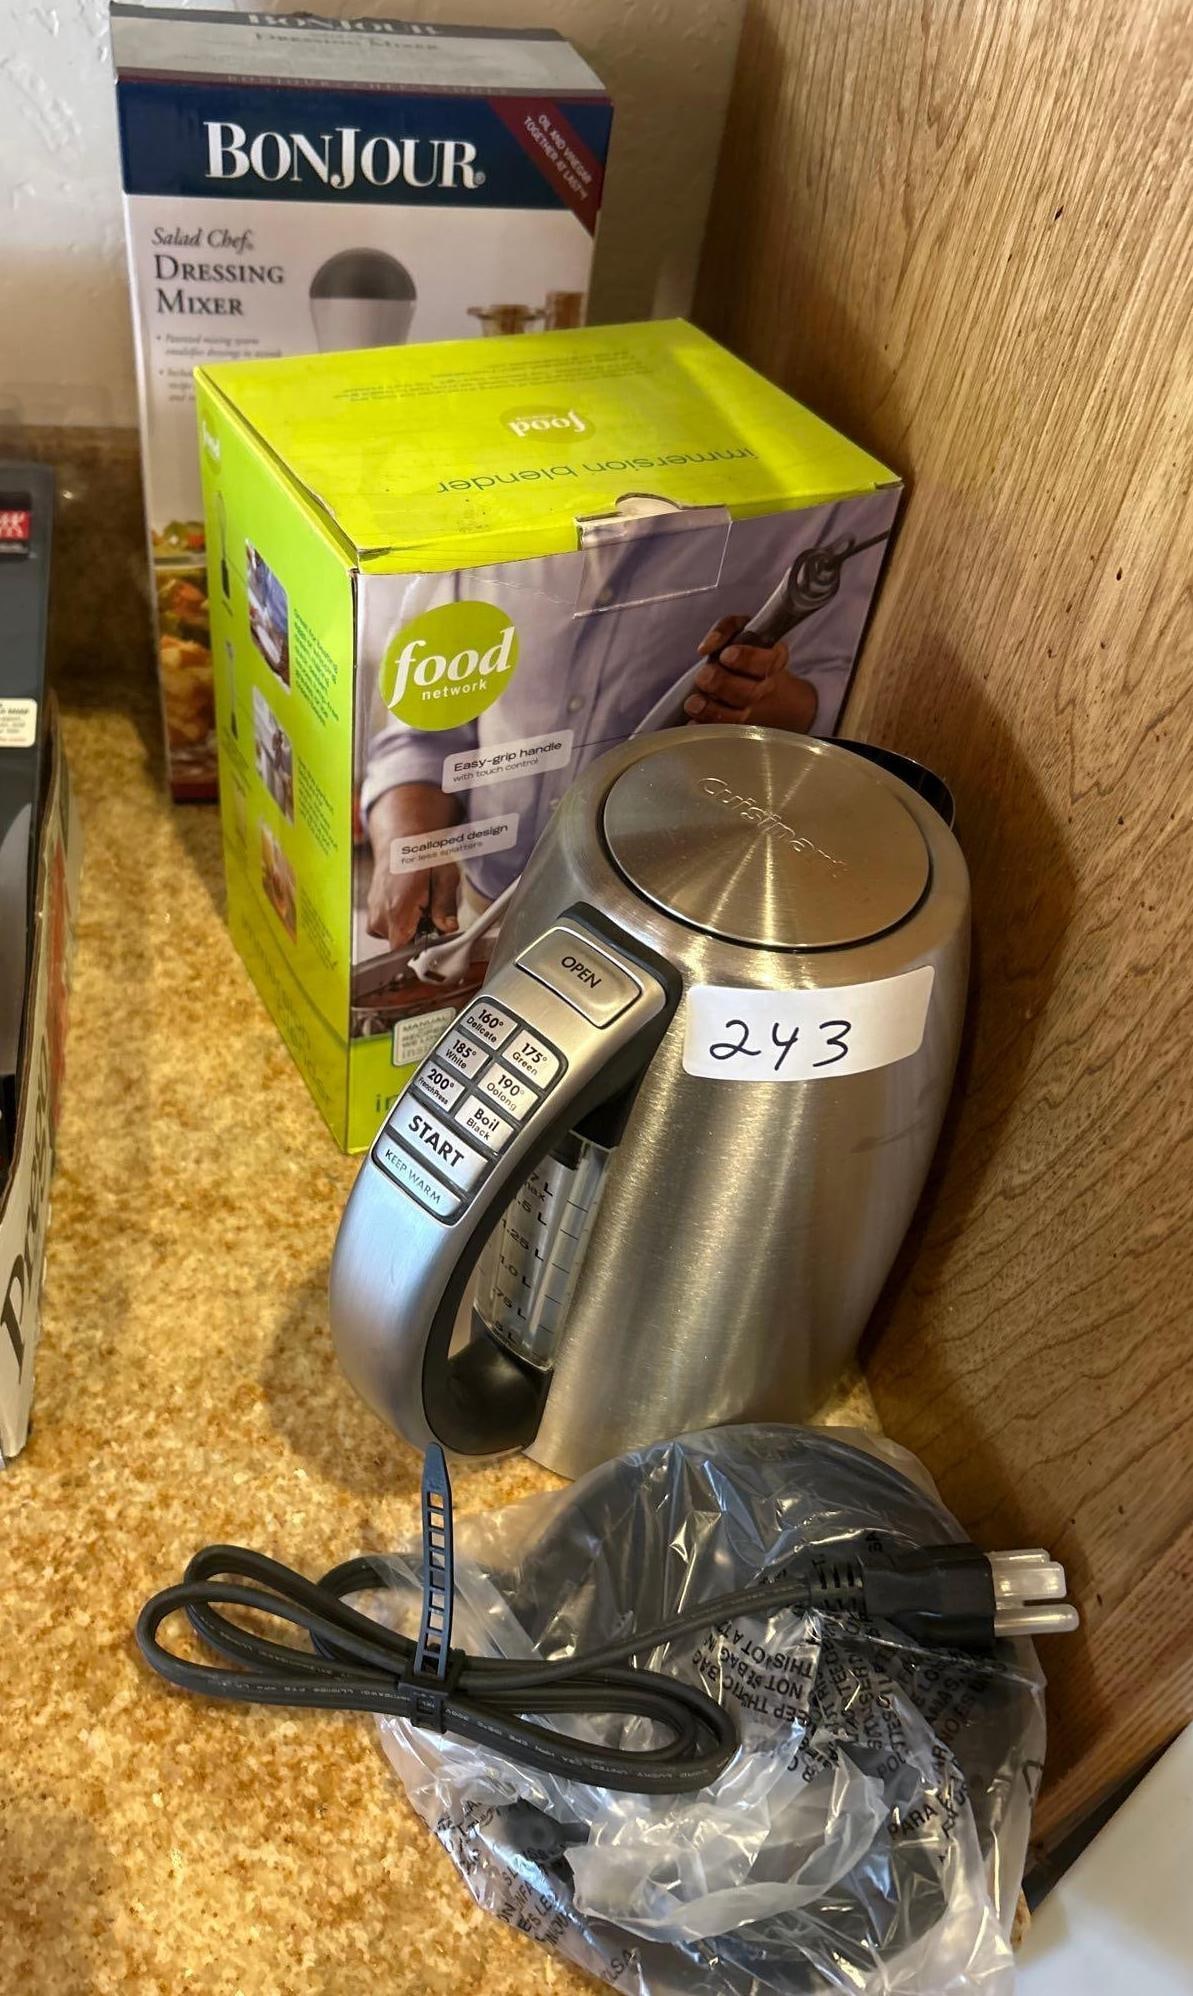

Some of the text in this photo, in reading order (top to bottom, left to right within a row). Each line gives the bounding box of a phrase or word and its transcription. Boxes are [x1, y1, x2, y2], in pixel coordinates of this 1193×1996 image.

[152, 227, 202, 247] Salad
[154, 254, 285, 285] DRESSING
[157, 288, 244, 316] MIXER
[508, 409, 586, 439] food
[436, 447, 756, 494] immersion blender
[388, 626, 515, 710] food
[422, 679, 488, 701] network
[454, 741, 562, 772] Easy-grip handle
[453, 772, 474, 783] with
[476, 766, 504, 777] touch
[401, 824, 508, 855] Scalloped design
[560, 955, 603, 989] OPEN
[466, 1016, 498, 1044] Delicate
[709, 1018, 852, 1071] 243
[445, 1048, 467, 1070] White
[512, 1051, 538, 1076] Green
[486, 1081, 517, 1112] Oolong
[466, 1117, 491, 1141] Black
[474, 1108, 499, 1132] Boil
[408, 1115, 464, 1167] START
[385, 1149, 442, 1205] KEEP WARM
[773, 1652, 813, 1679] THIS
[765, 1675, 803, 1700] NOT
